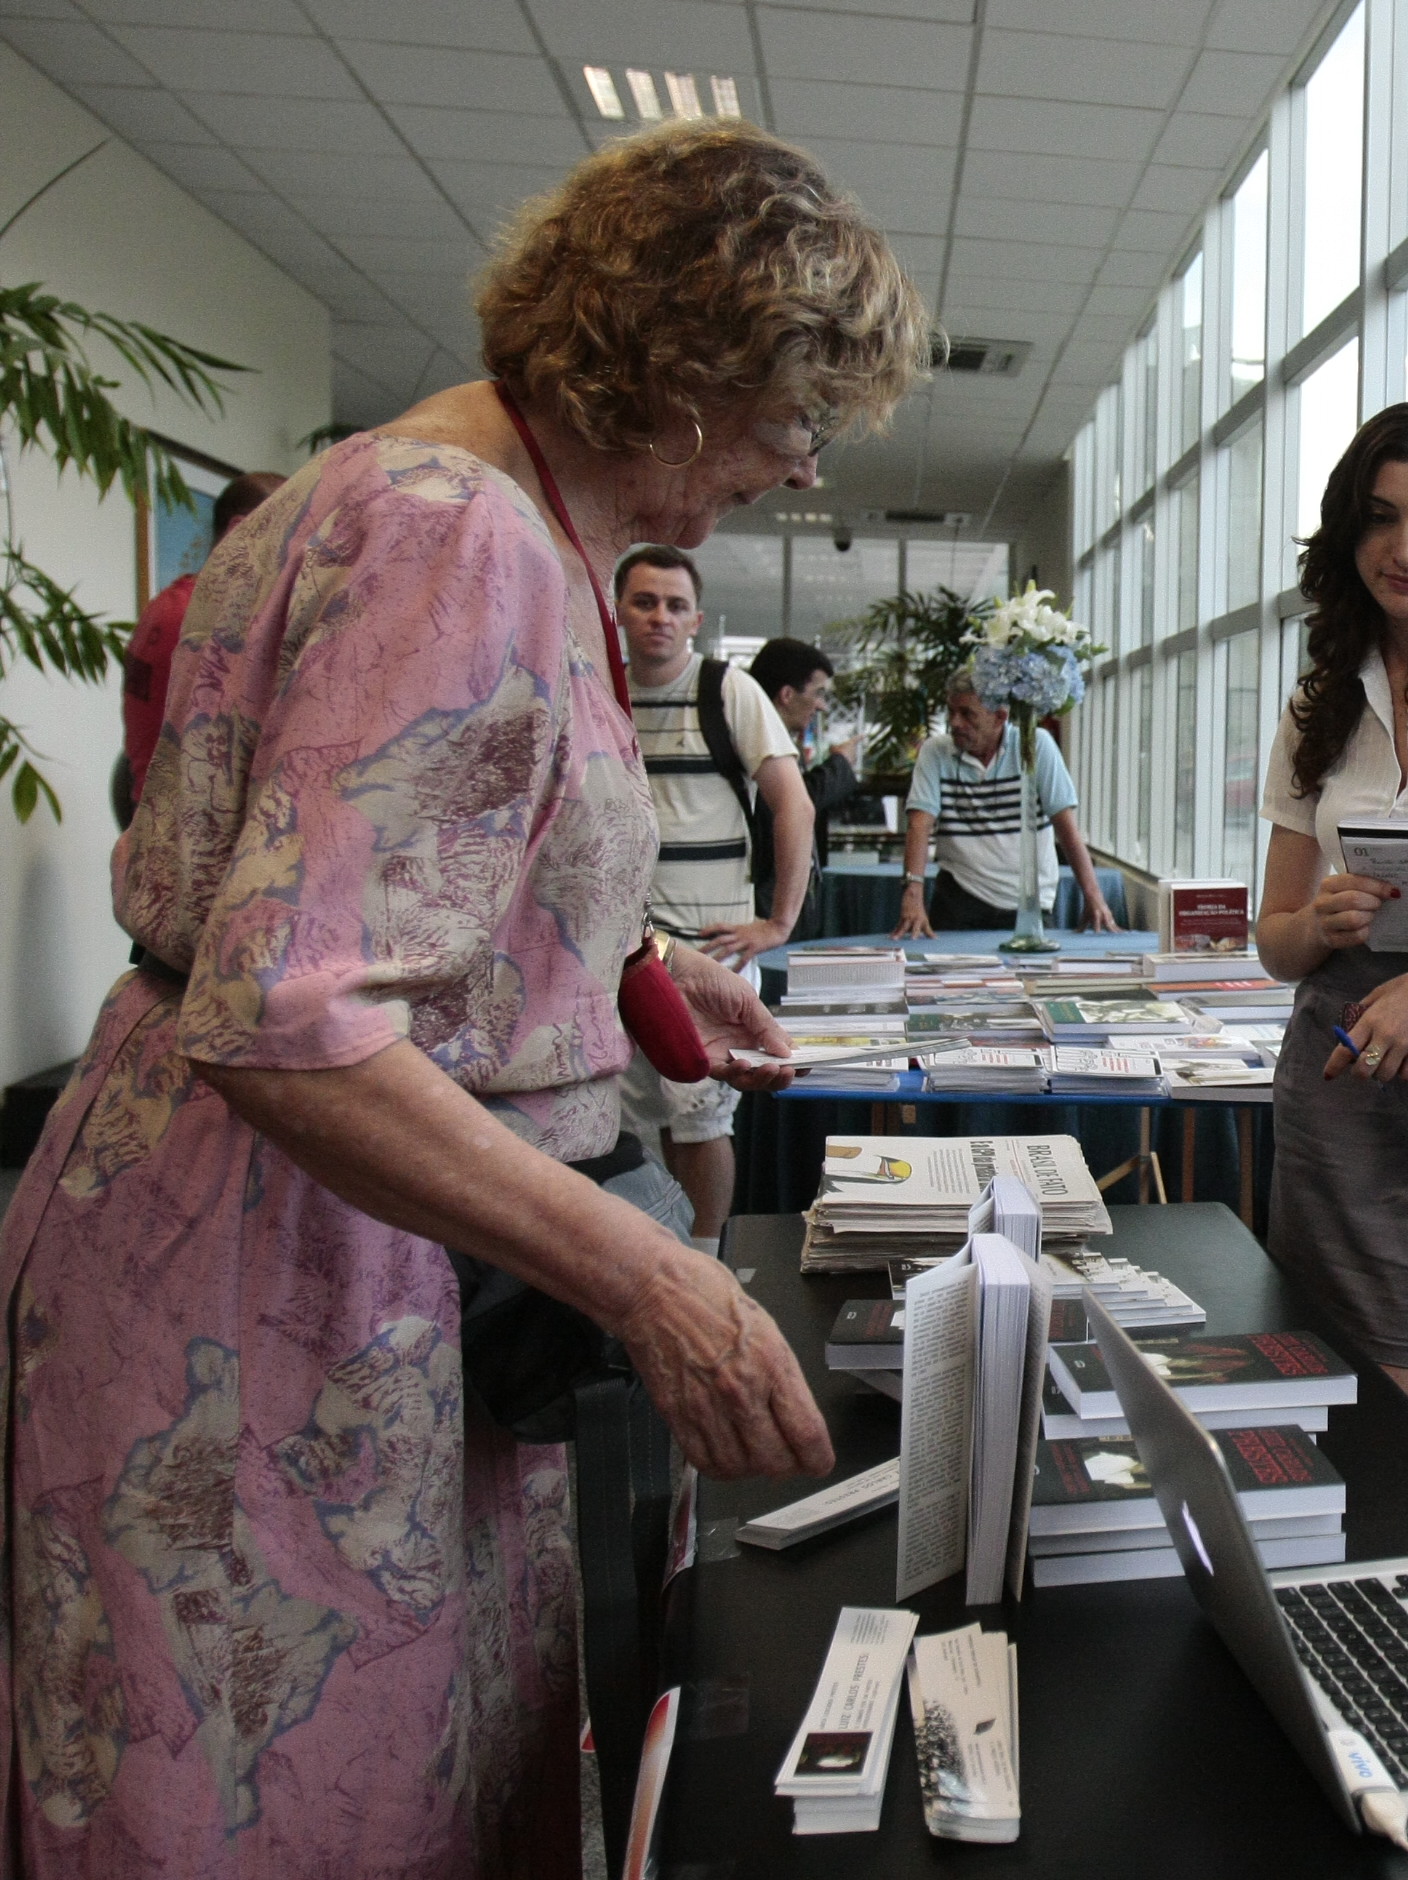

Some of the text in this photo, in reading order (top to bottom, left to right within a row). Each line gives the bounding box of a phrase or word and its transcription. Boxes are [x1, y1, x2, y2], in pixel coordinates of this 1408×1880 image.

[1027, 1145, 1068, 1196] BRASIL DE FATO
[1348, 1752, 1373, 1777] vivo
